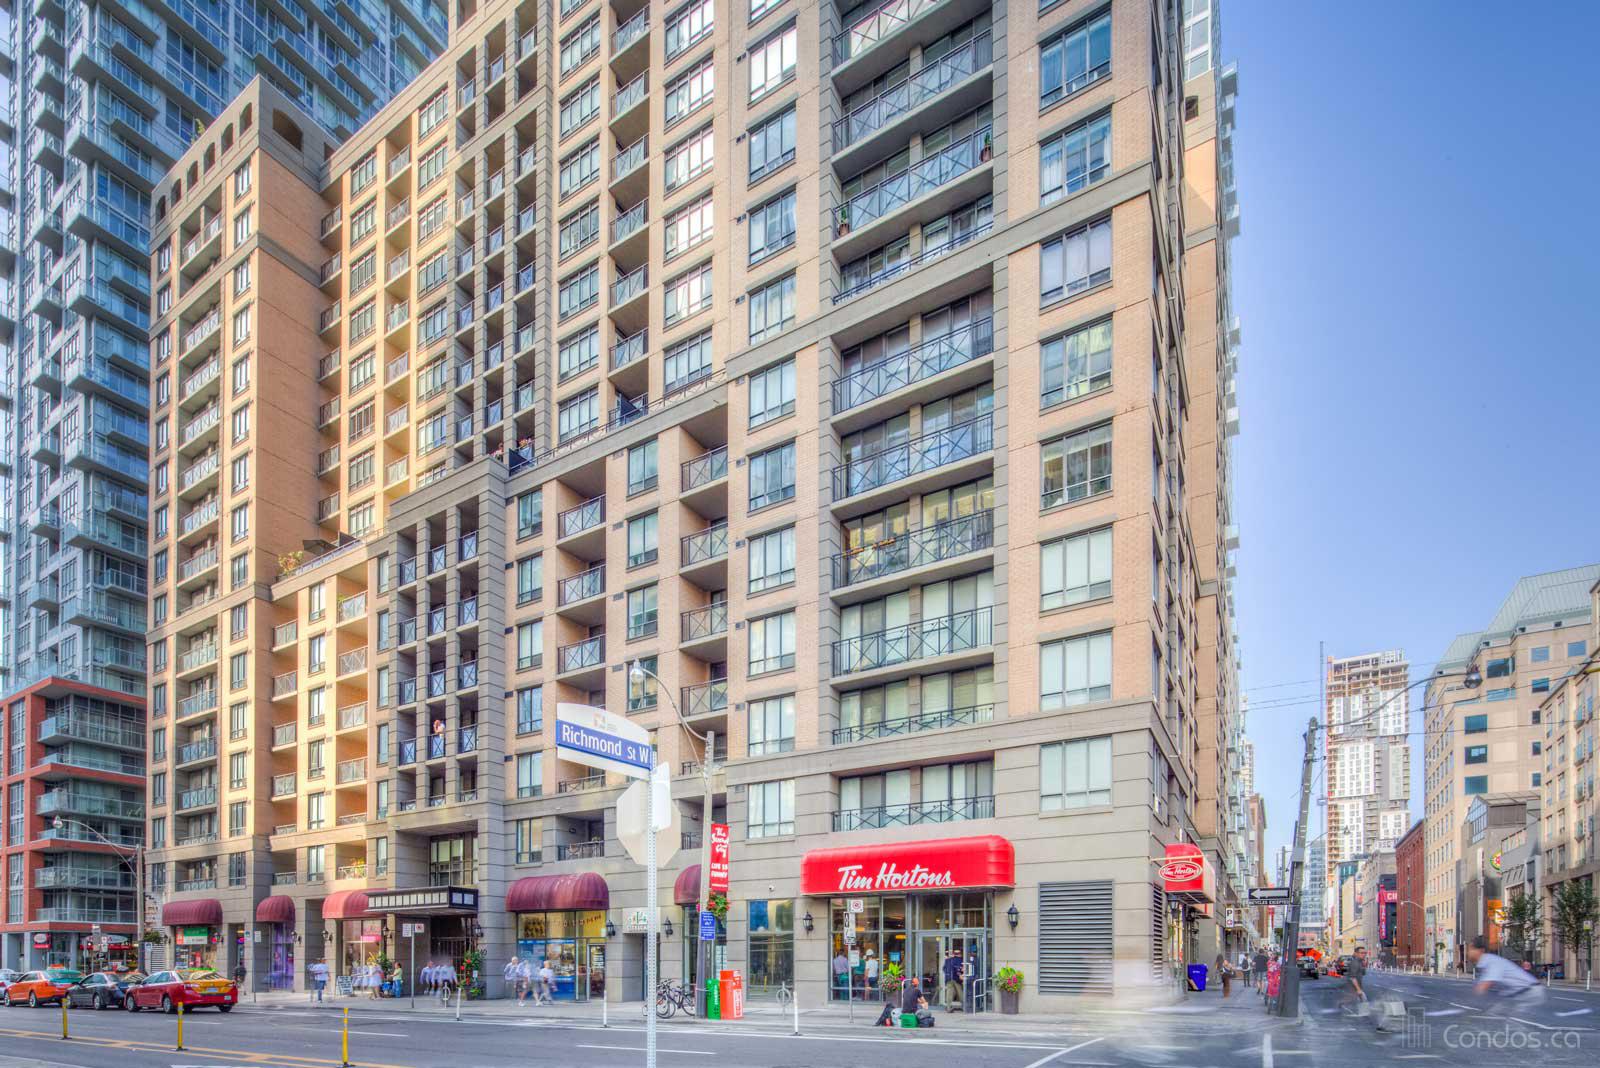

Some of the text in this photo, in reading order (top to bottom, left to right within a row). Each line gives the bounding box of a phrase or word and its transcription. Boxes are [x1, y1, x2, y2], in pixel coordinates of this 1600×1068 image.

[562, 724, 622, 756] Richmond
[627, 746, 636, 760] St
[640, 747, 649, 763] W
[838, 865, 871, 890] Tim
